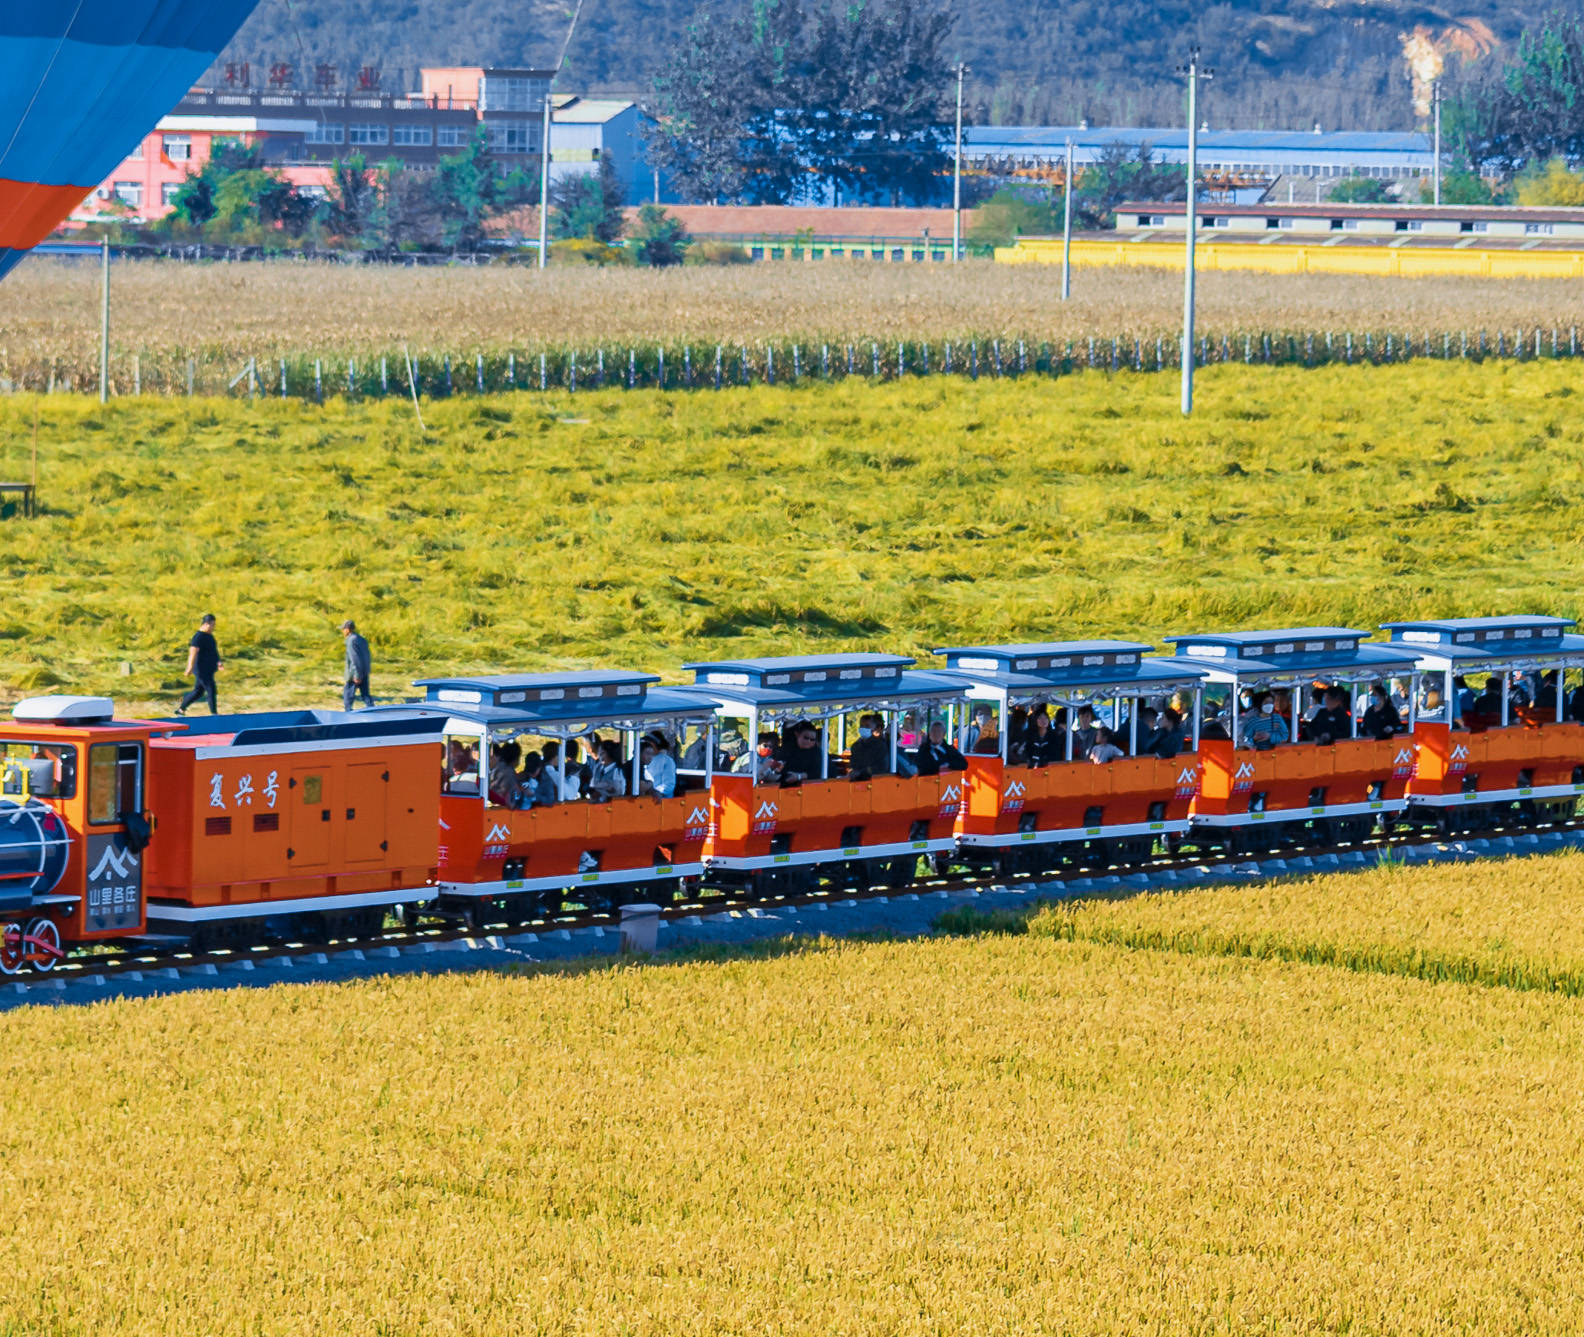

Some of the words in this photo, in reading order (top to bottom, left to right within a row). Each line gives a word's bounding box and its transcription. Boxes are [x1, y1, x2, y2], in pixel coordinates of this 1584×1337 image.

[210, 770, 279, 810] 复兴号
[89, 885, 136, 906] 山里各庄
